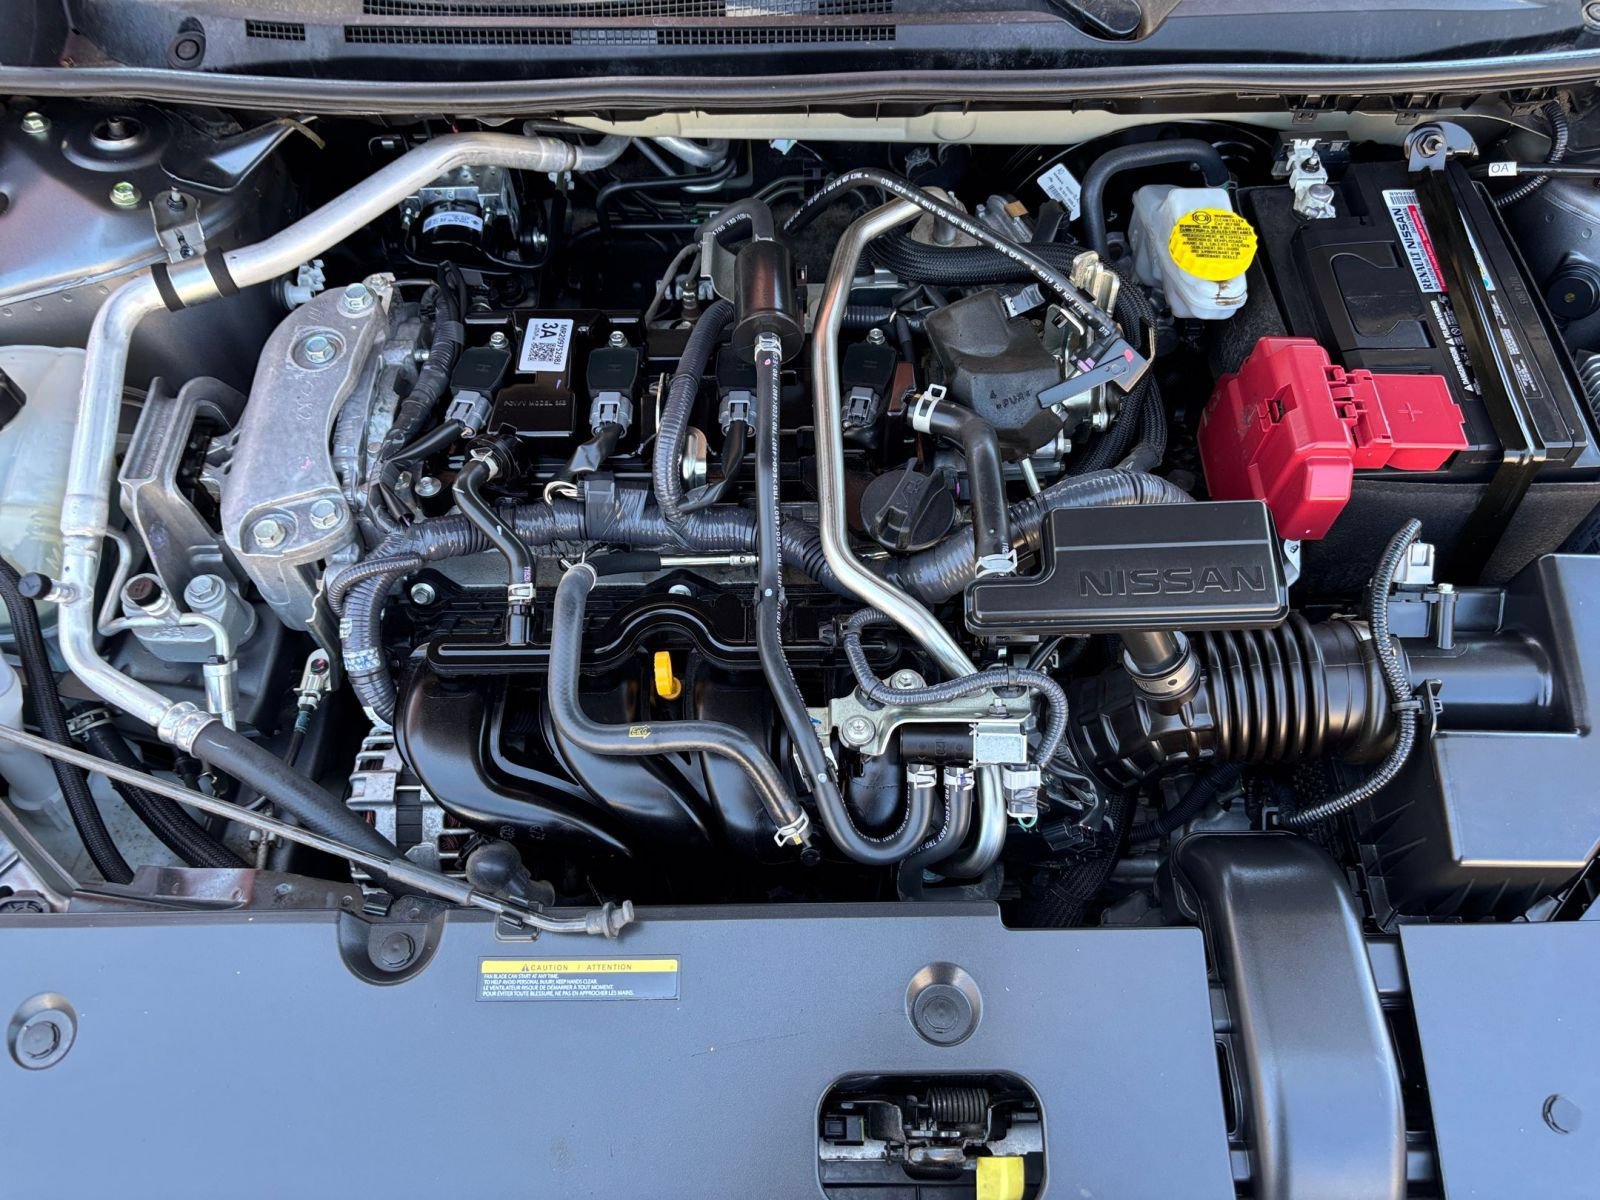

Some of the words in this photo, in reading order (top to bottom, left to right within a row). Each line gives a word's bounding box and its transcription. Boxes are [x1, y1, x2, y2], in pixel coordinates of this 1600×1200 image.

[948, 215, 960, 225] NOT
[1391, 208, 1416, 248] NISSAN
[1409, 251, 1433, 289] RENAULT
[1063, 290, 1074, 303] NOT
[539, 322, 559, 338] 3A
[1078, 565, 1266, 597] NISSAN
[586, 963, 632, 971] ATTENTION
